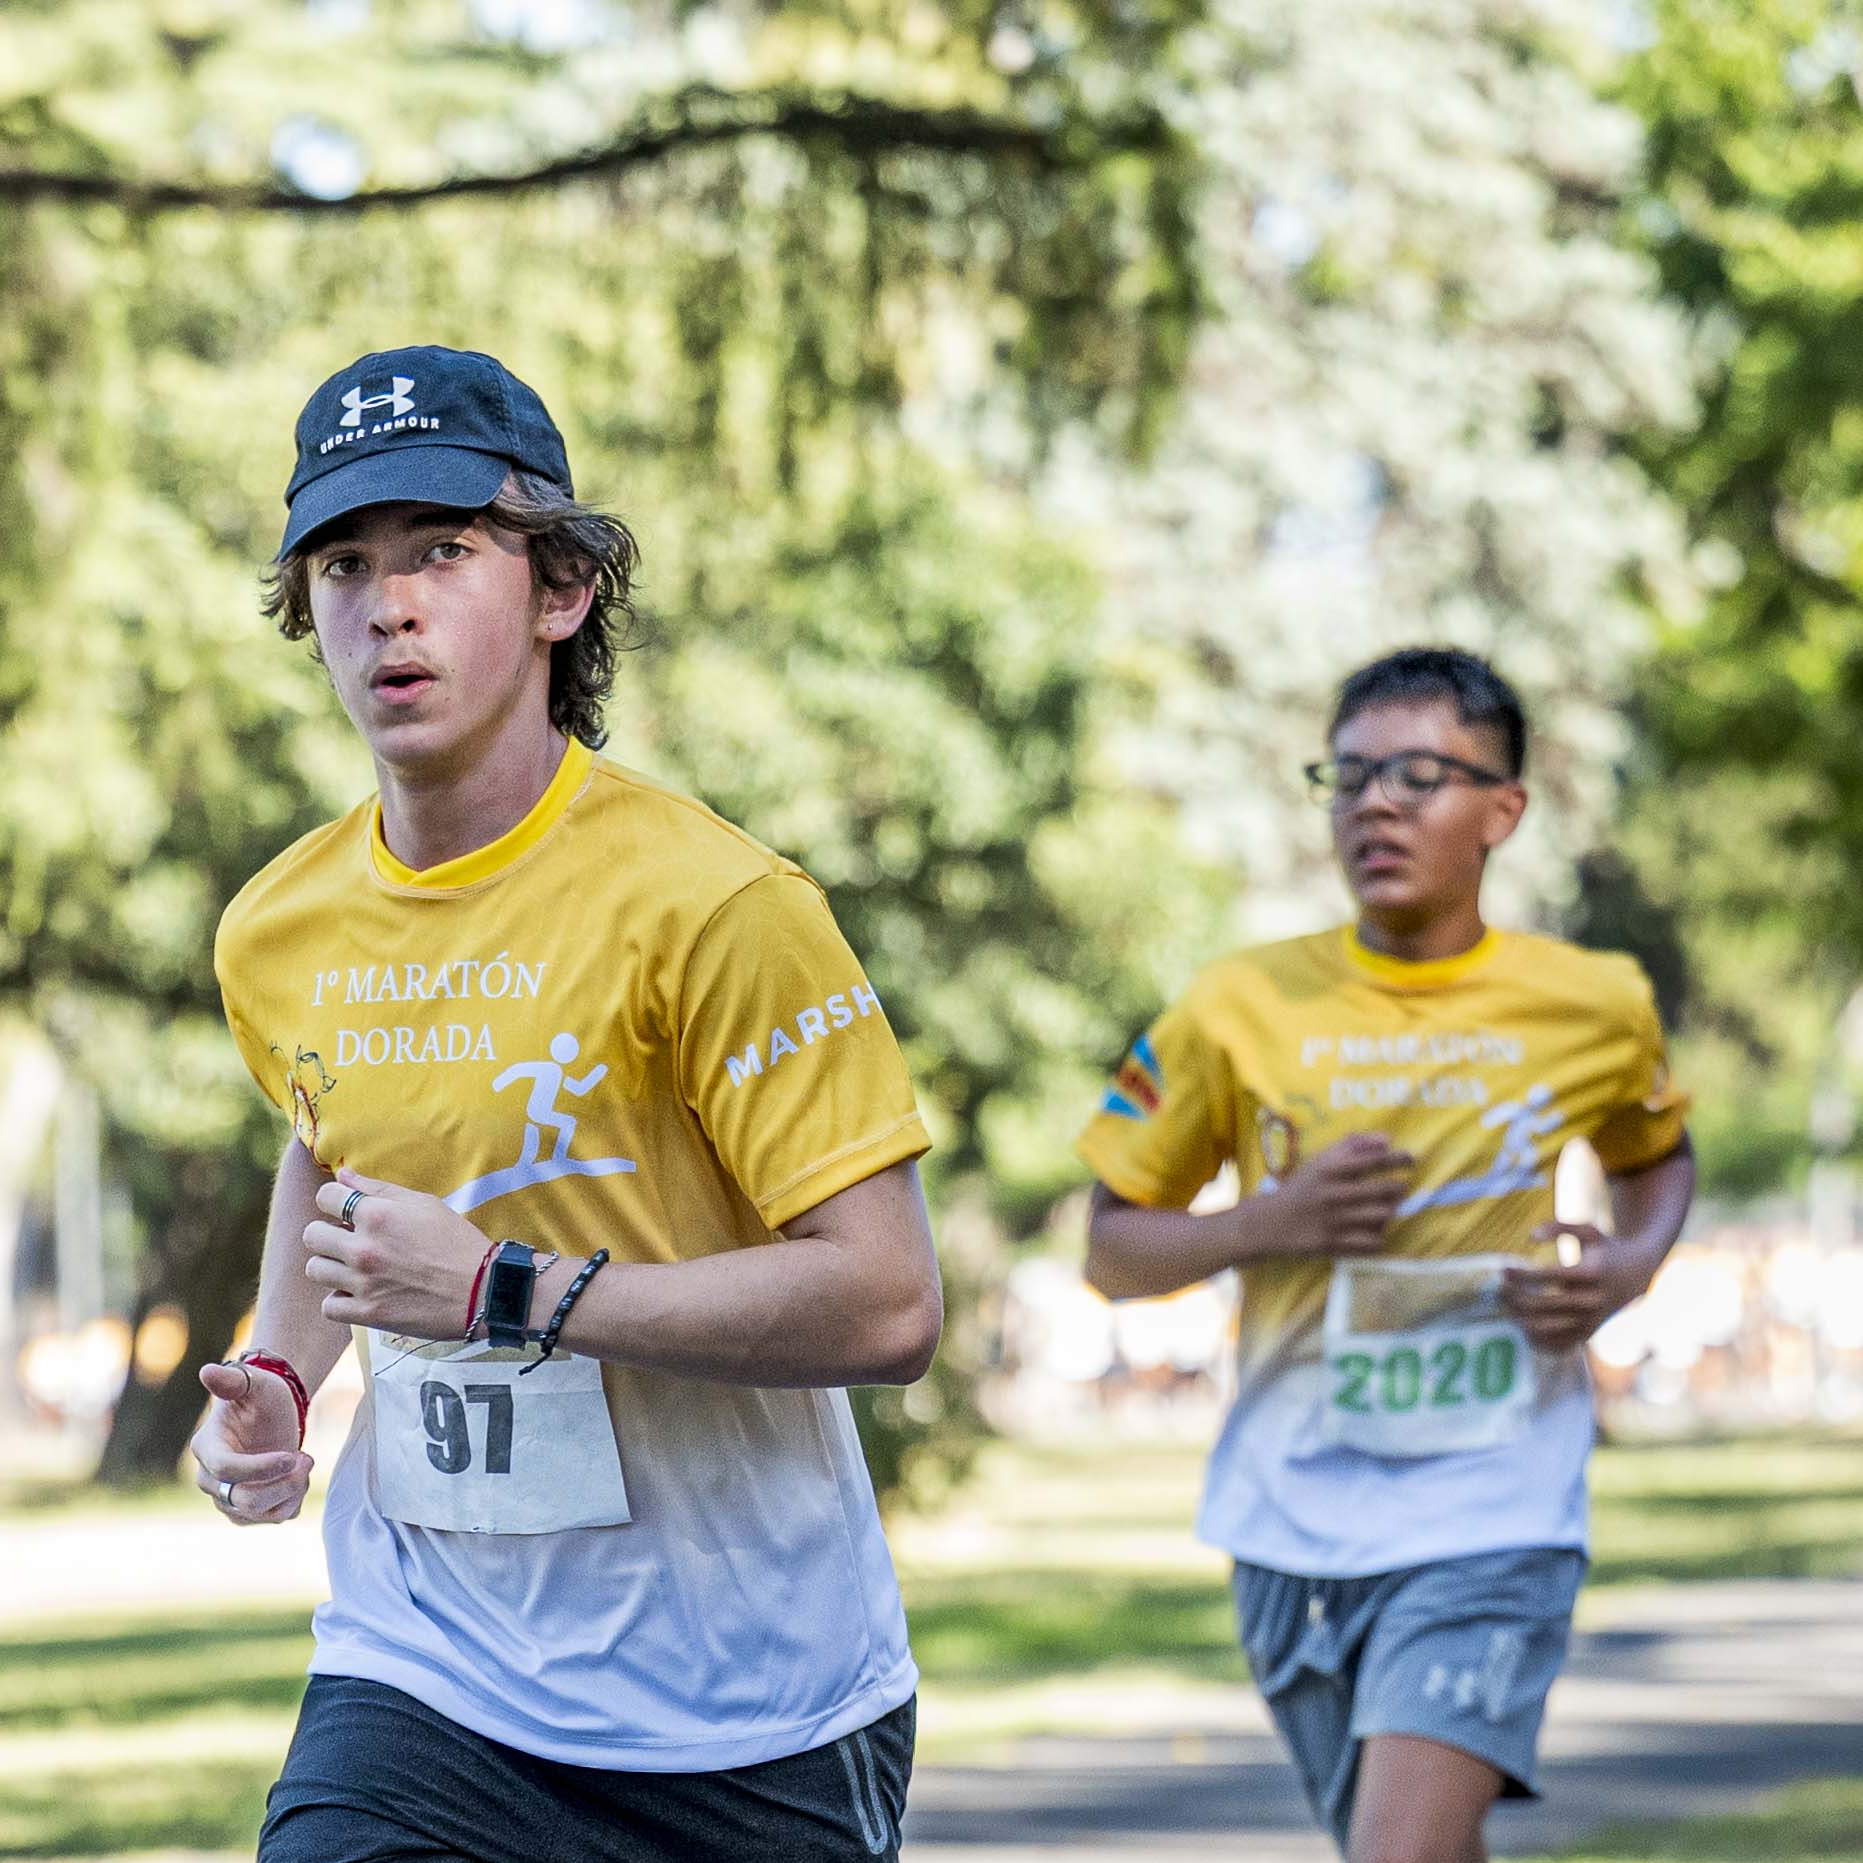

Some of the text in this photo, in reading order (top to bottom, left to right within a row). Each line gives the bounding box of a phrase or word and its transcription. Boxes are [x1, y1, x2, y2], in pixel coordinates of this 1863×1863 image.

[319, 416, 440, 455] UNDER ARMOUR
[343, 950, 547, 1005] MARATÓN
[334, 1023, 498, 1067] DORADA
[1333, 1337, 1517, 1416] 2020
[419, 1380, 514, 1475] 97
